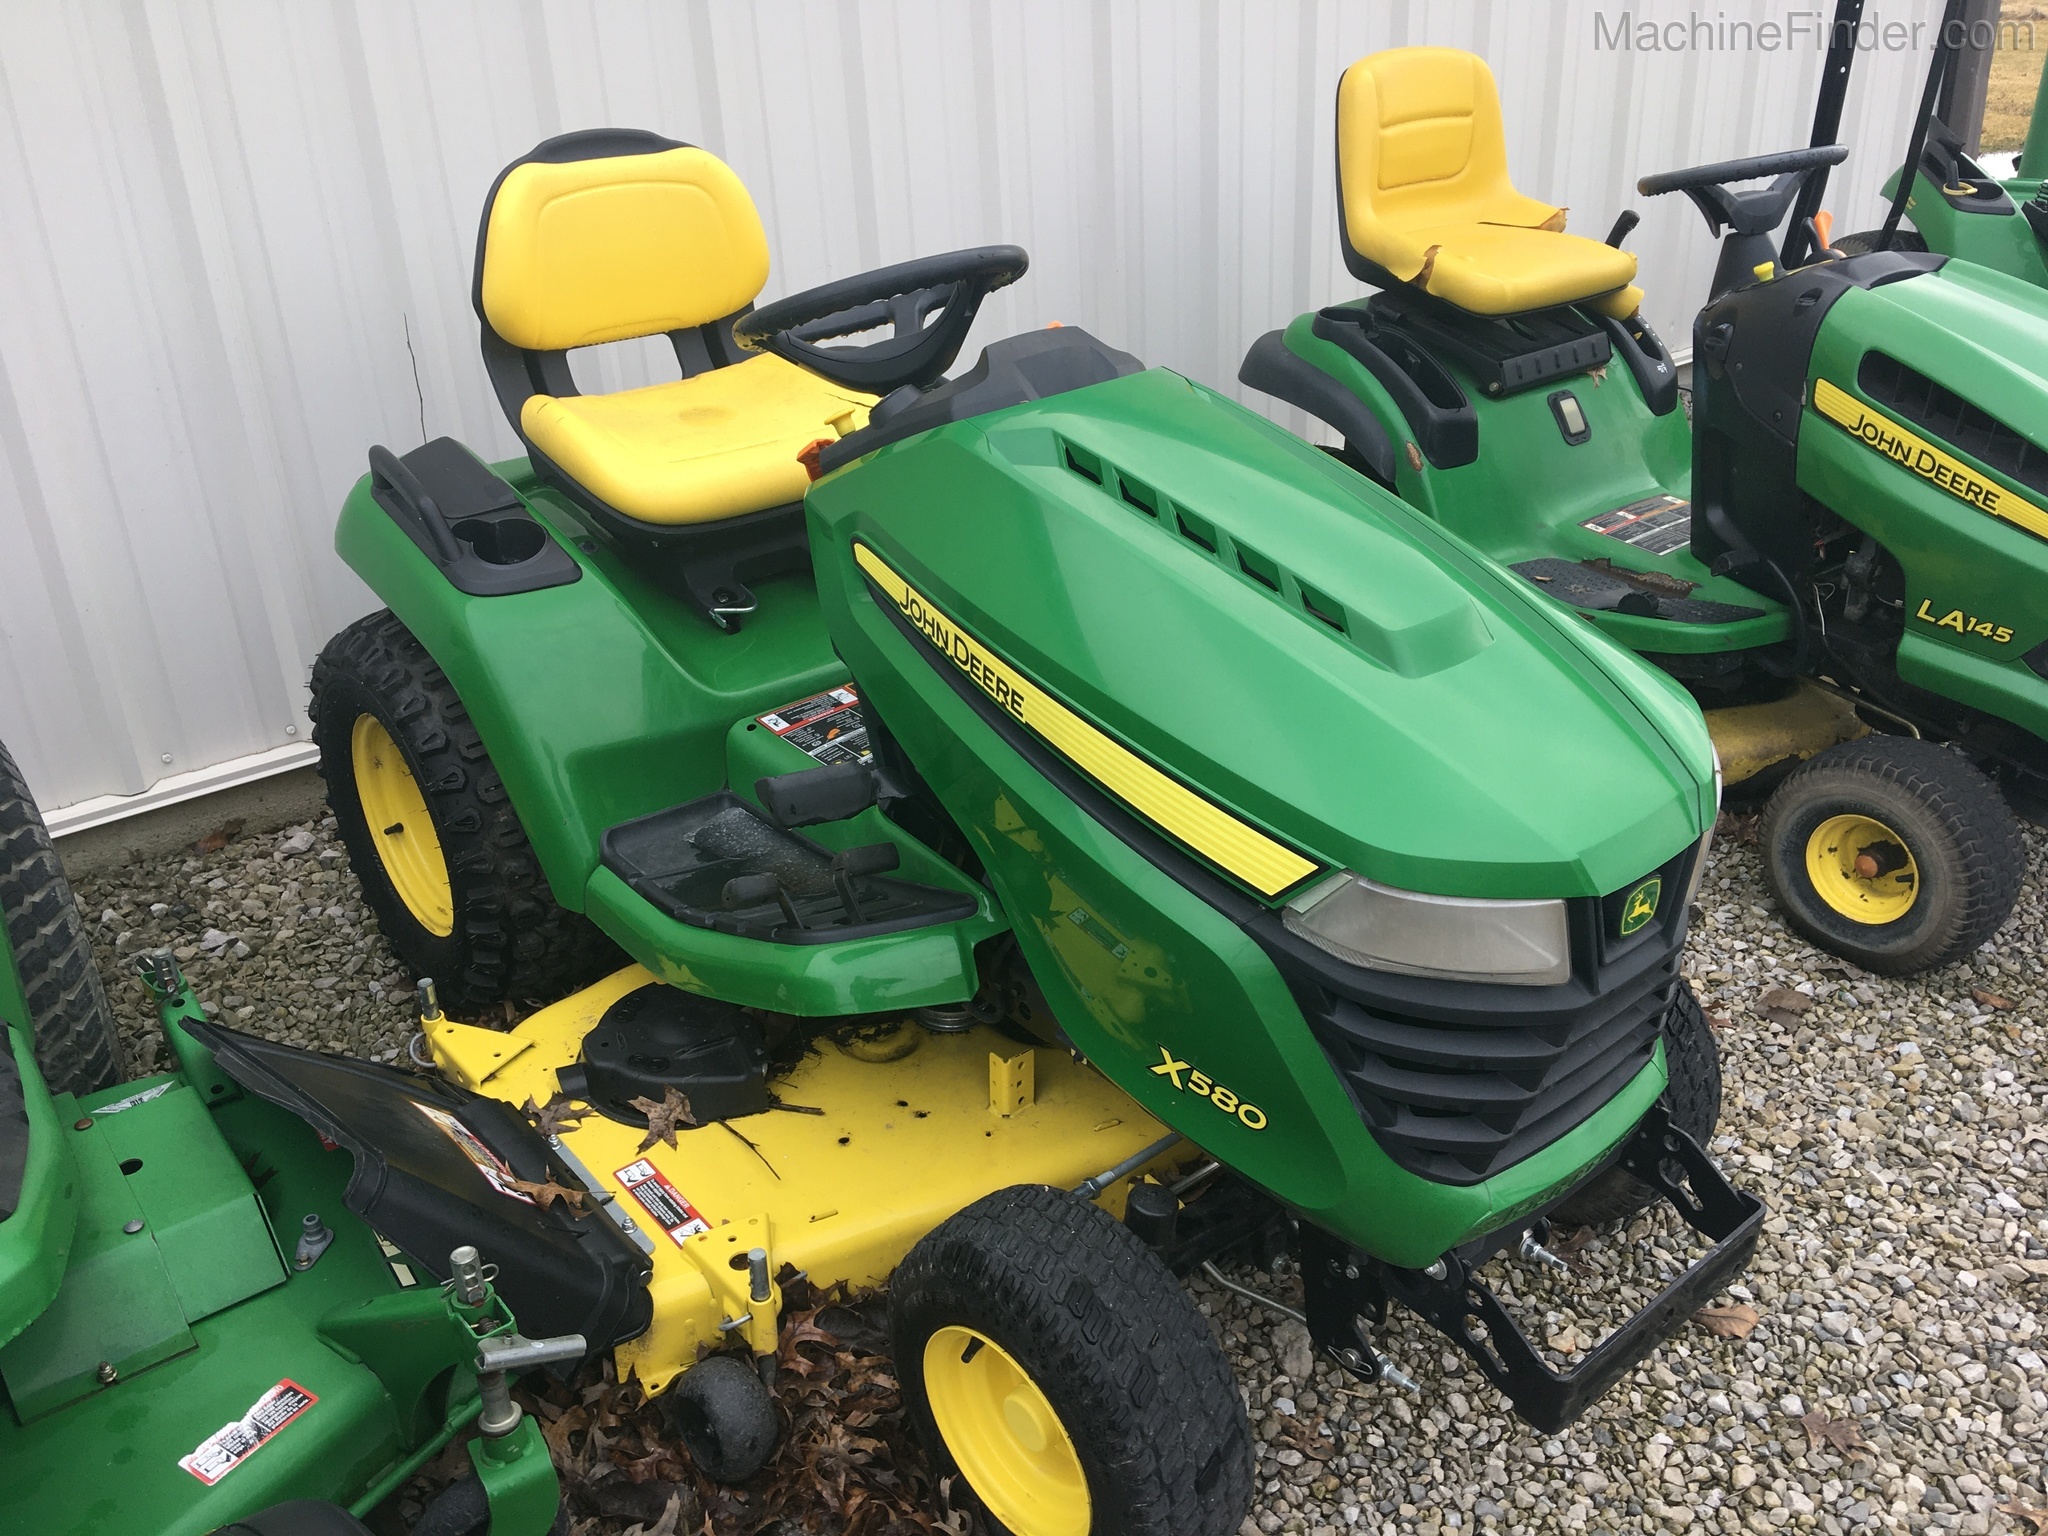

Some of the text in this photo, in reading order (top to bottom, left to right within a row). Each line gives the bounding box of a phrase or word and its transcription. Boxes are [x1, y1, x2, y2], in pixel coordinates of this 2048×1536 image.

[1848, 414, 2001, 512] JOHN DEERE
[899, 586, 1025, 718] JOHN DEERE
[1916, 599, 2015, 644] LA145
[1149, 1045, 1268, 1130] X580
[669, 1187, 691, 1209] DANGER
